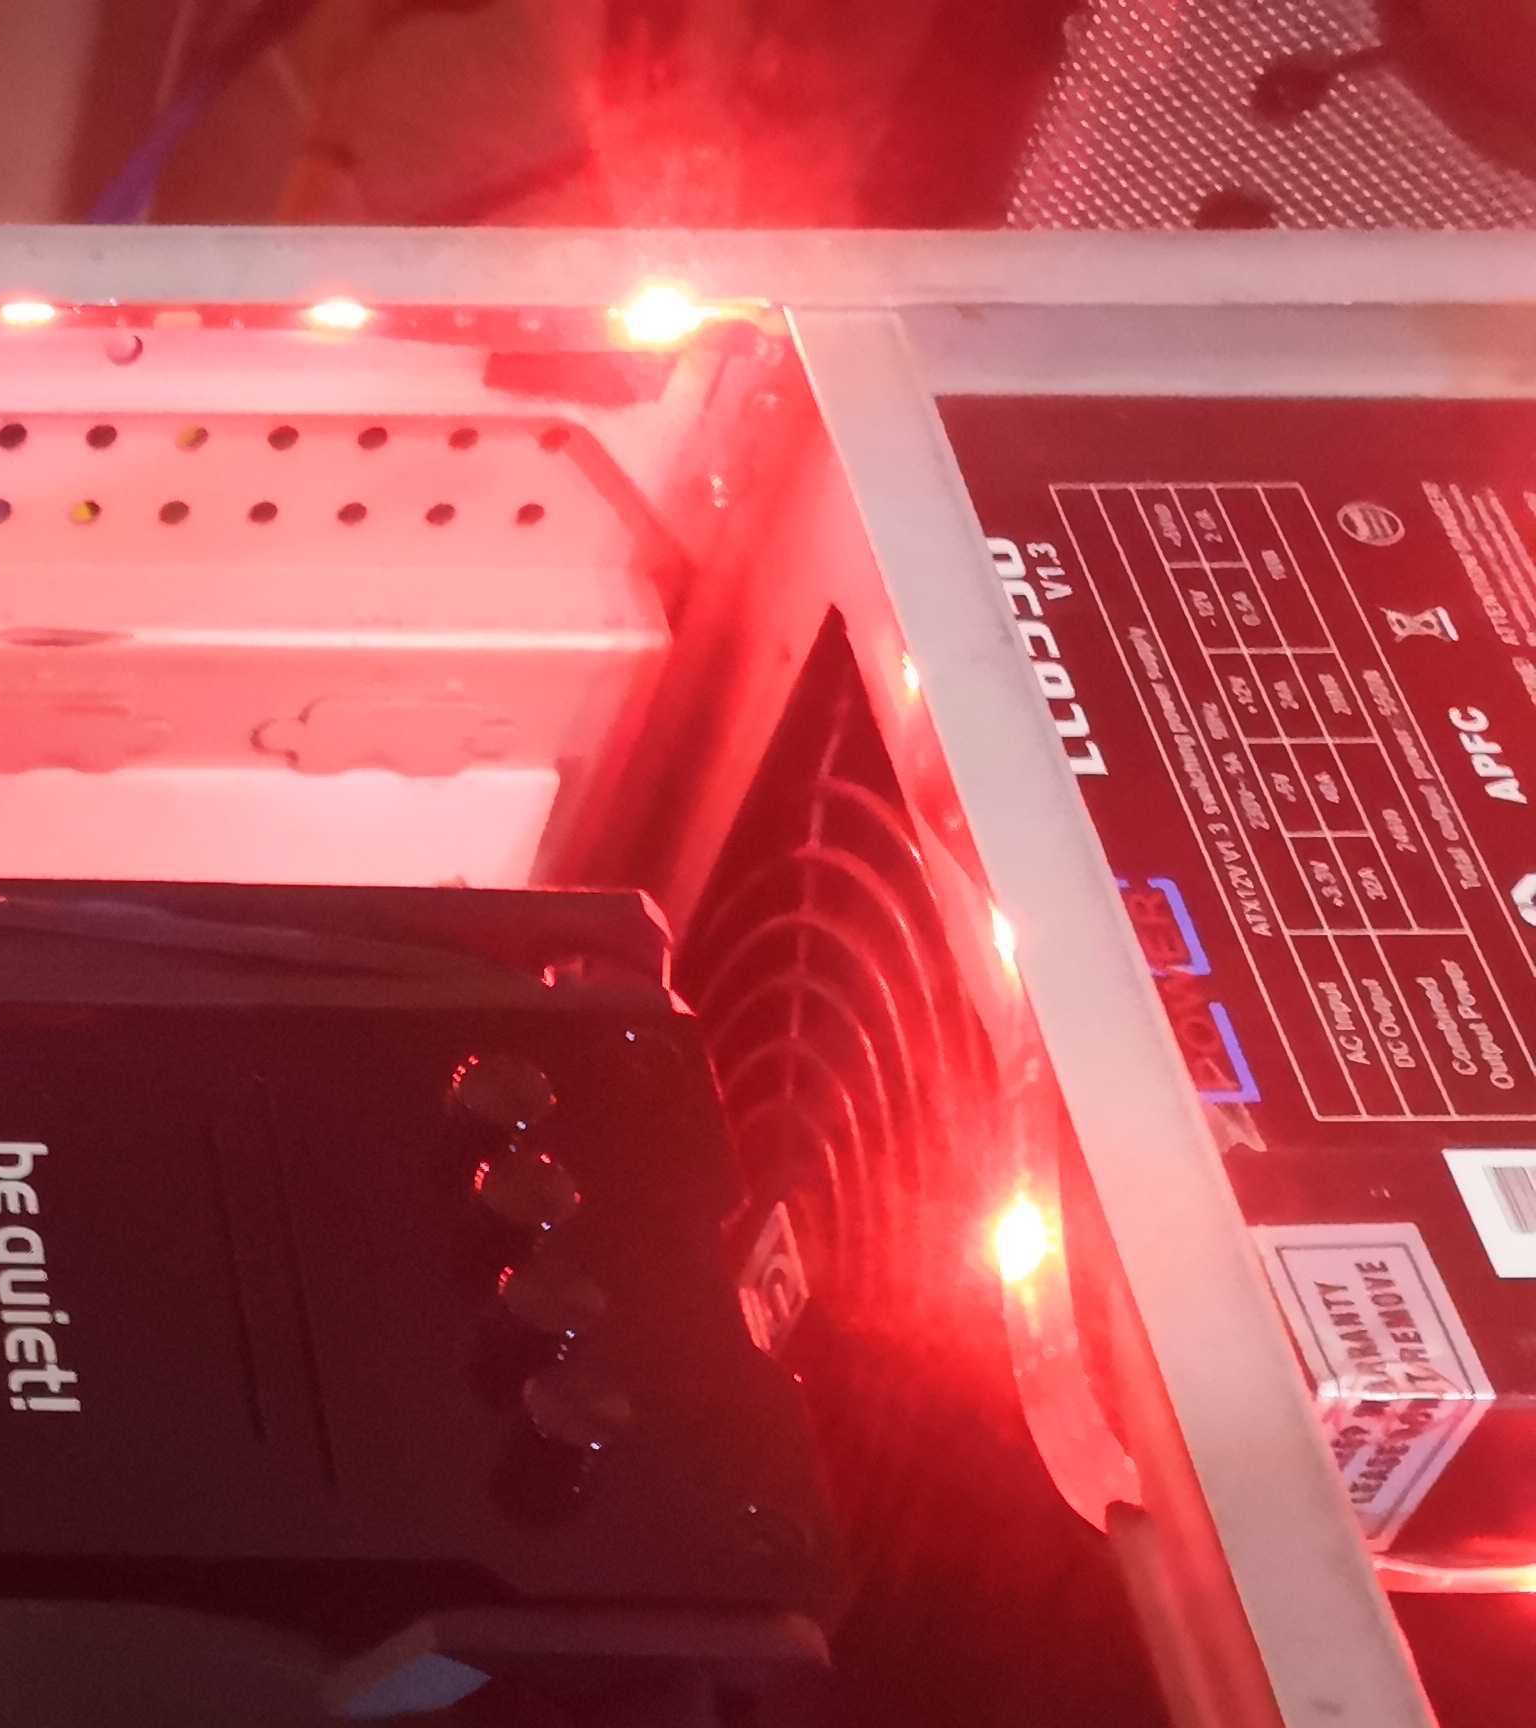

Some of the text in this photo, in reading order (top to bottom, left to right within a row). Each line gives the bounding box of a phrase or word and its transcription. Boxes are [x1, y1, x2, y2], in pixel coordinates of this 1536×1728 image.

[1027, 542, 1073, 600] V1.3
[1448, 706, 1528, 803] APFC
[1318, 982, 1370, 1065] AC Input
[1361, 978, 1416, 1068] DC Output
[1441, 959, 1514, 1089] Output Power
